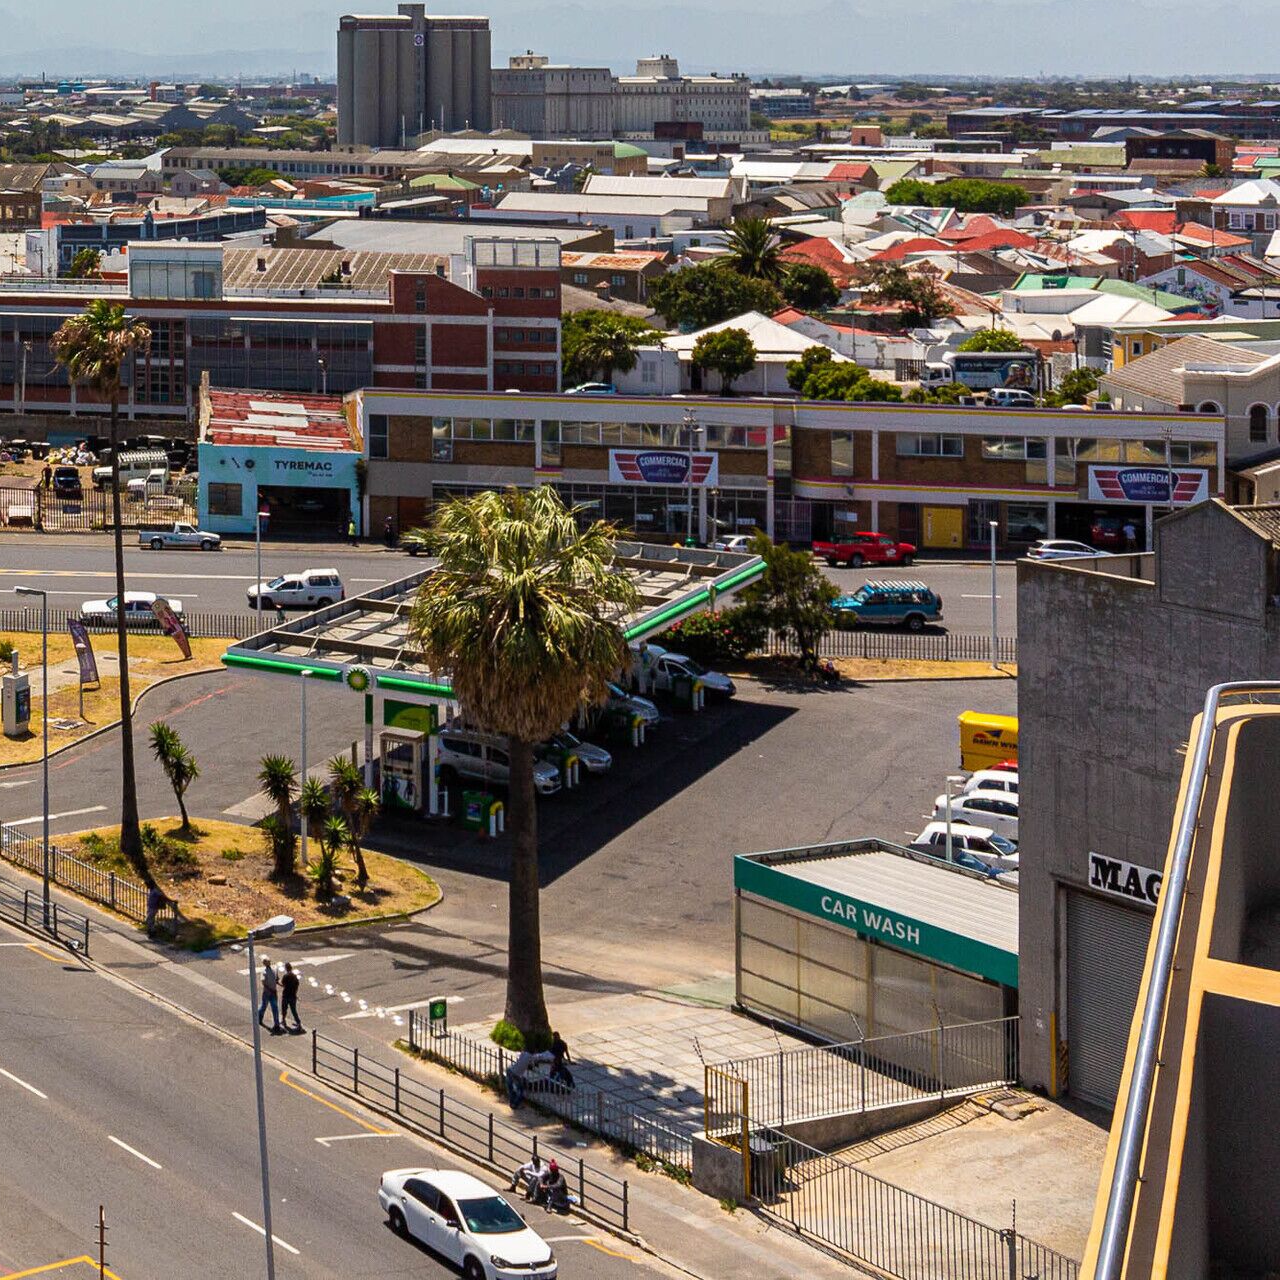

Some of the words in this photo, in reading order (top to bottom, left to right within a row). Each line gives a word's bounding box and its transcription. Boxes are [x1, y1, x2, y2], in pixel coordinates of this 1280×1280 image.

[274, 460, 333, 471] TYREMAC
[640, 455, 687, 468] COMMERCIAL
[1122, 472, 1170, 485] COMMERCIA
[821, 896, 858, 923] CAR
[863, 909, 920, 945] WASH
